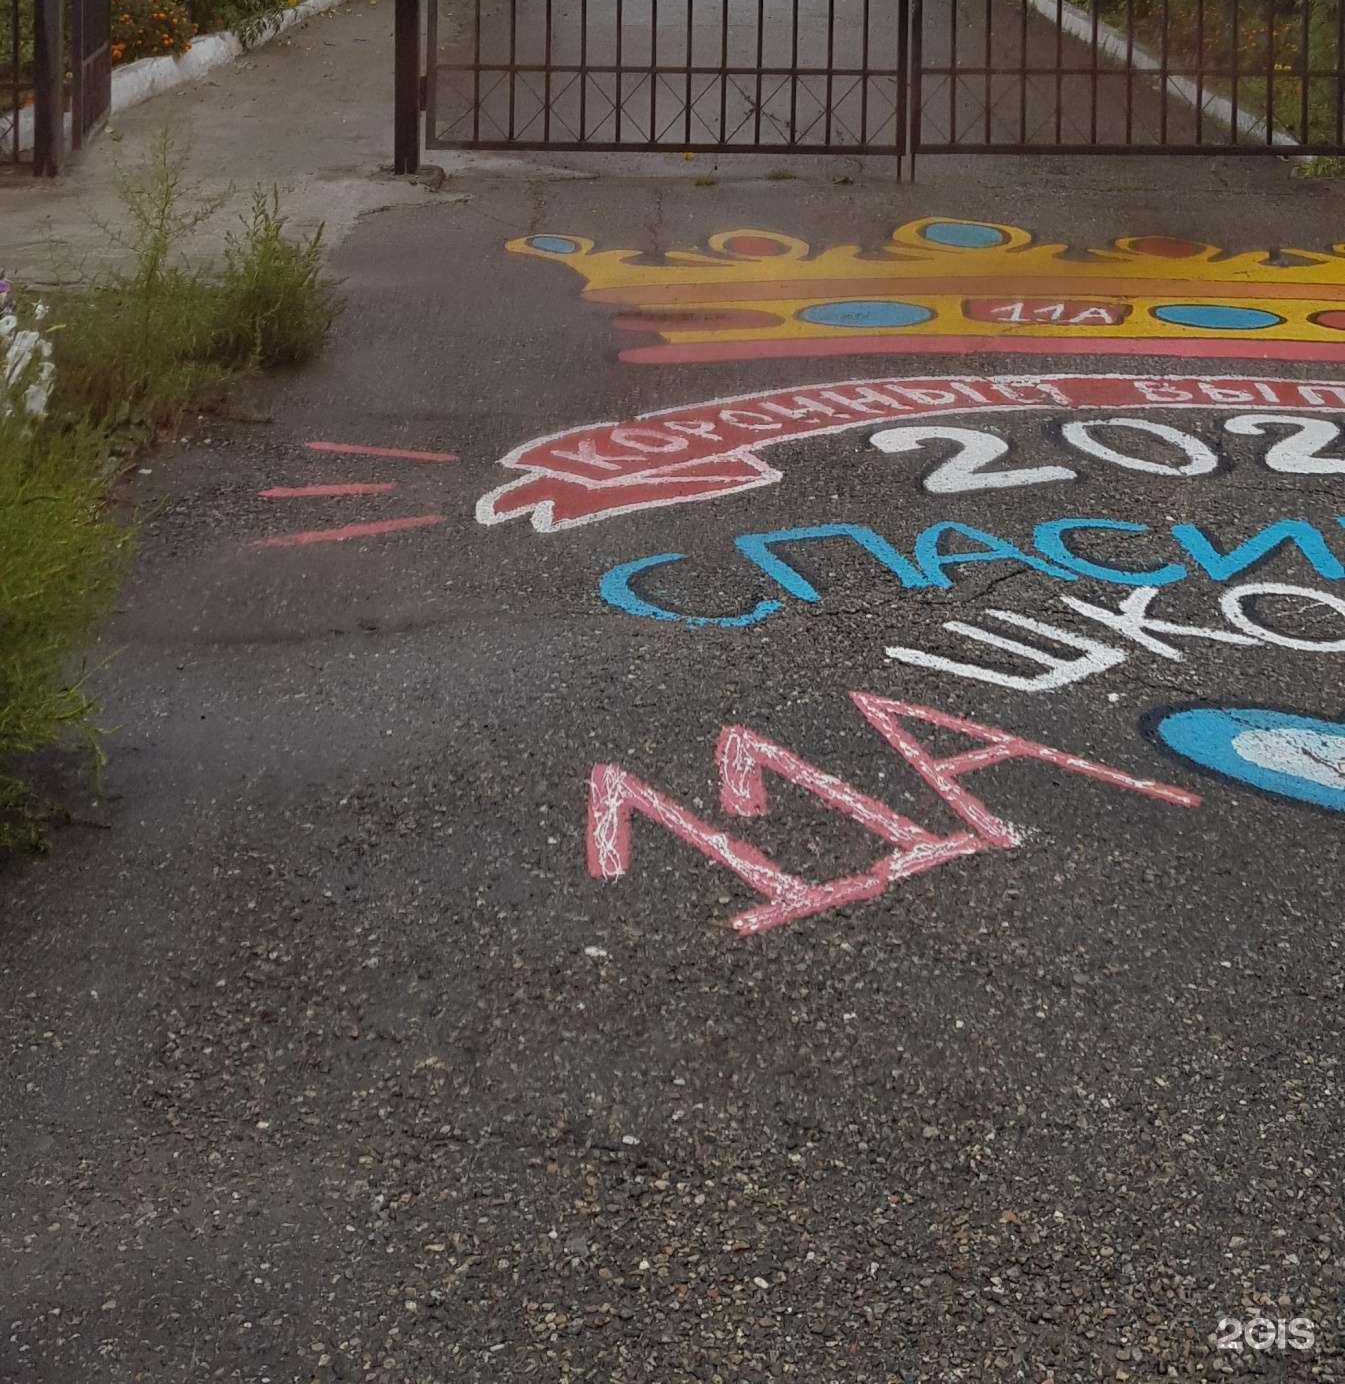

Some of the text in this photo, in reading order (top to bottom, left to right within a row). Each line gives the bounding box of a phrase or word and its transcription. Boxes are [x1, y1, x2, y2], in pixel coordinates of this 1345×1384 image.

[989, 302, 1113, 324] 11А
[870, 413, 1345, 494] 202
[600, 515, 1345, 629] СПАСИ
[885, 581, 1345, 693] ШКО
[587, 690, 1202, 935] 11А
